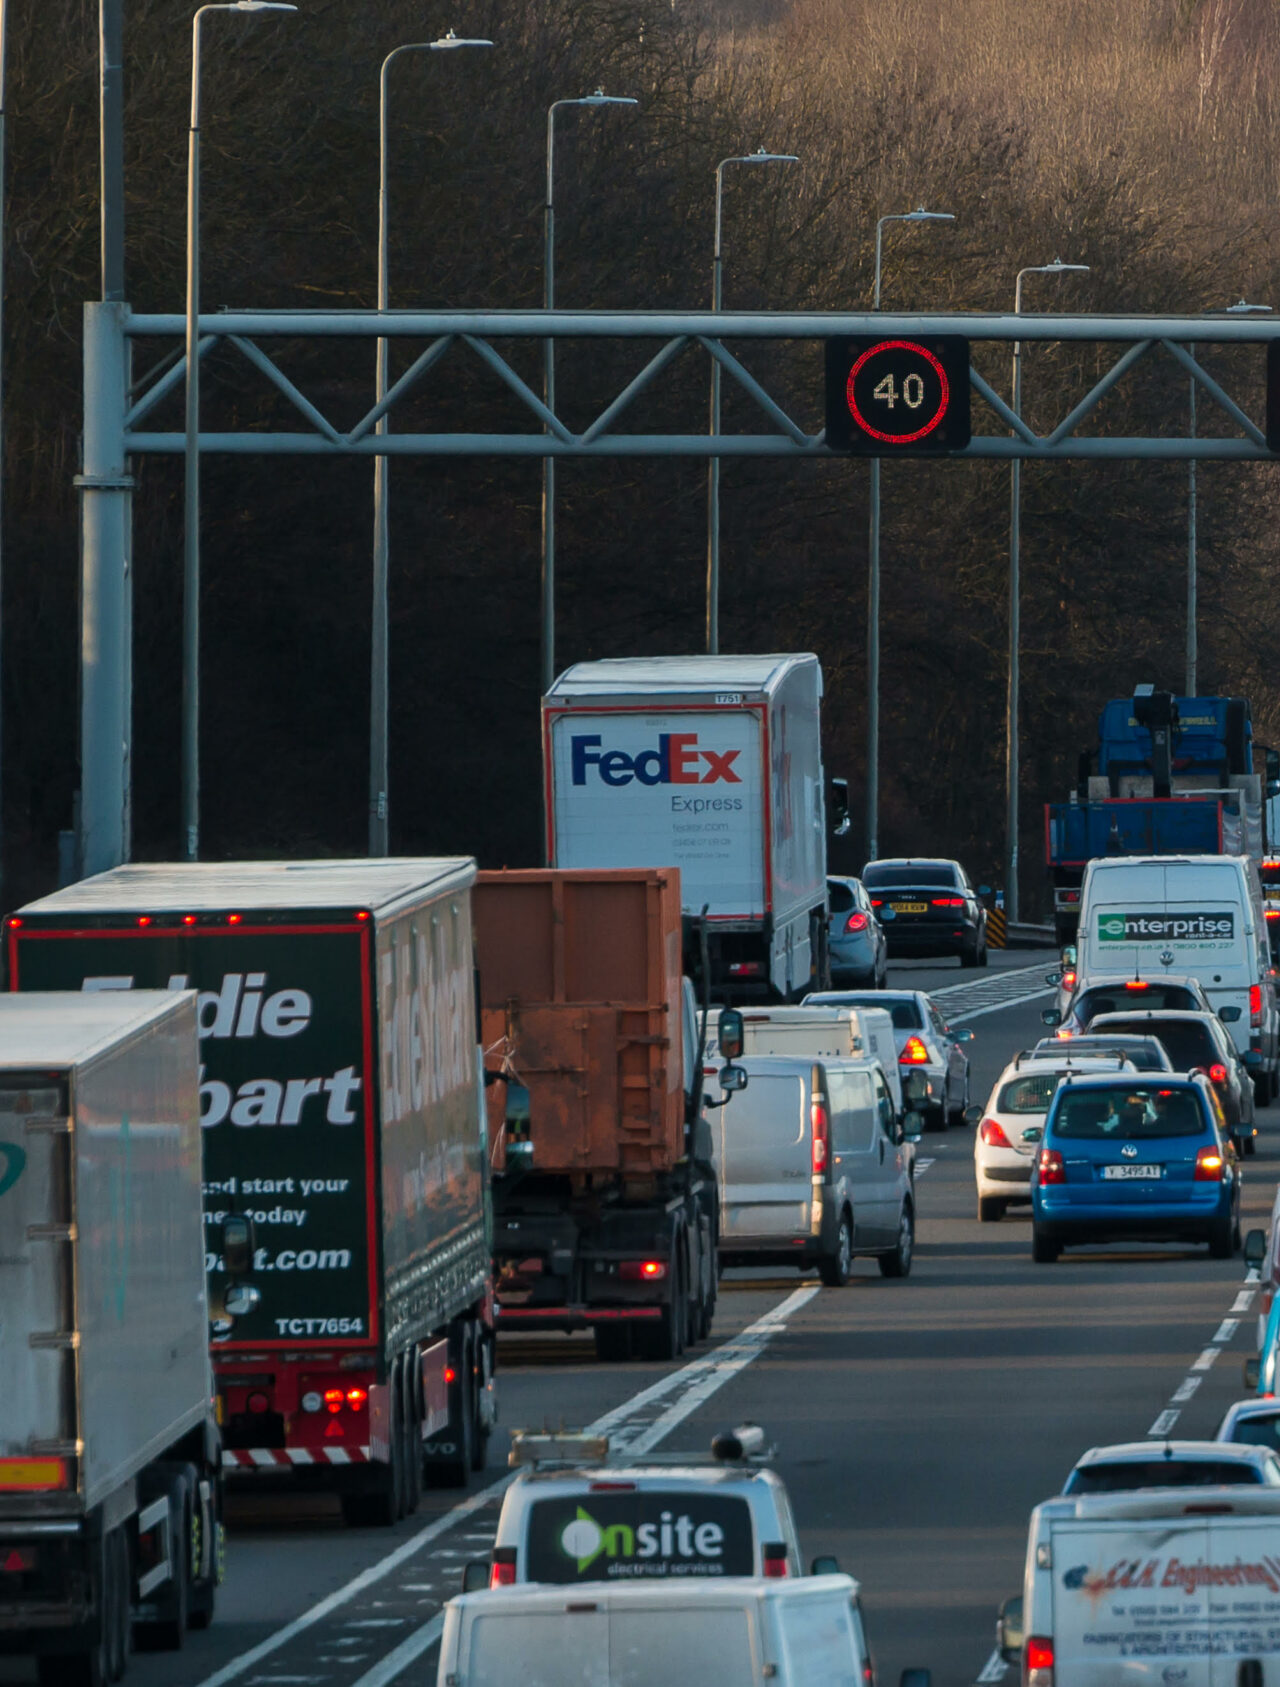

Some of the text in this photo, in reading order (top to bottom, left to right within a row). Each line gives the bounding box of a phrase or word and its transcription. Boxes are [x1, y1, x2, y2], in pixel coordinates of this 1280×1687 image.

[872, 372, 925, 409] 40
[571, 733, 743, 786] FedEx
[671, 795, 743, 815] Express
[1101, 916, 1232, 937] enterprise
[241, 1177, 295, 1194] start
[299, 1178, 349, 1197] your
[274, 1317, 364, 1335] TCT7654
